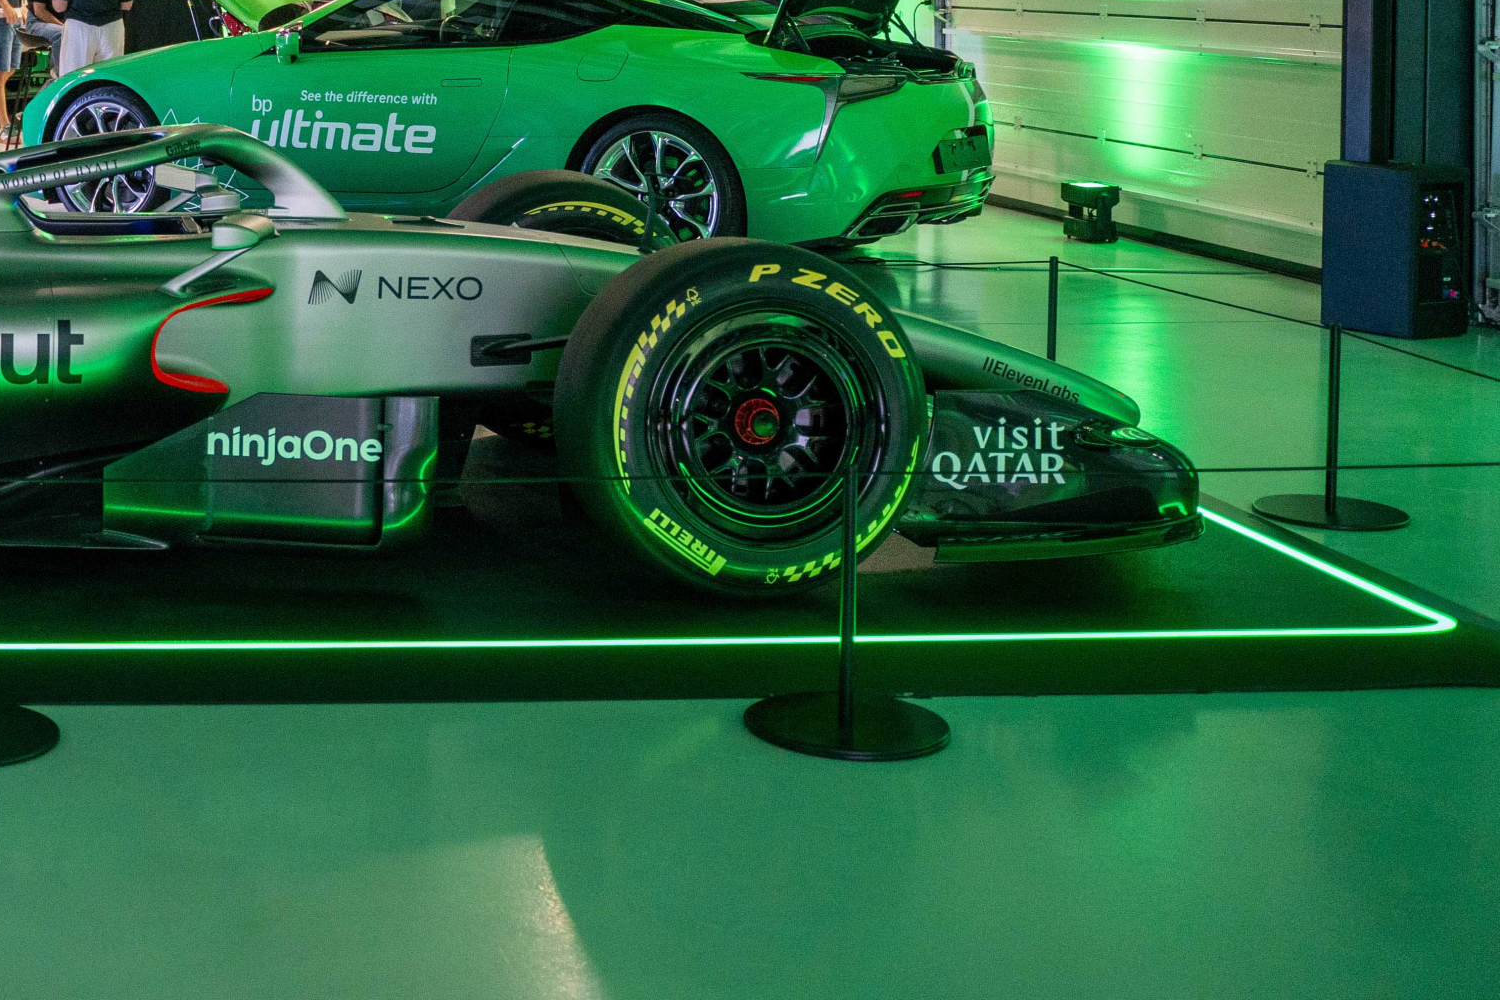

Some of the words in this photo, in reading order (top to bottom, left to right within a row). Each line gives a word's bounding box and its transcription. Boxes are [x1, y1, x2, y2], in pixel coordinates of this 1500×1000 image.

[252, 95, 273, 116] bp
[300, 89, 322, 102] See
[325, 91, 343, 102] the
[346, 91, 408, 105] difference
[411, 93, 437, 105] with
[251, 109, 437, 154] ultimate
[1, 172, 47, 190] WORLD
[53, 167, 69, 182] OF
[75, 159, 120, 177] HYATT
[378, 276, 483, 300] NEXO
[749, 264, 781, 282] P
[791, 268, 906, 358] ZERO
[207, 425, 383, 466] ninjaOne
[973, 416, 1065, 450] visit
[932, 451, 1066, 490] QATAR
[643, 507, 727, 576] PIRELLI
